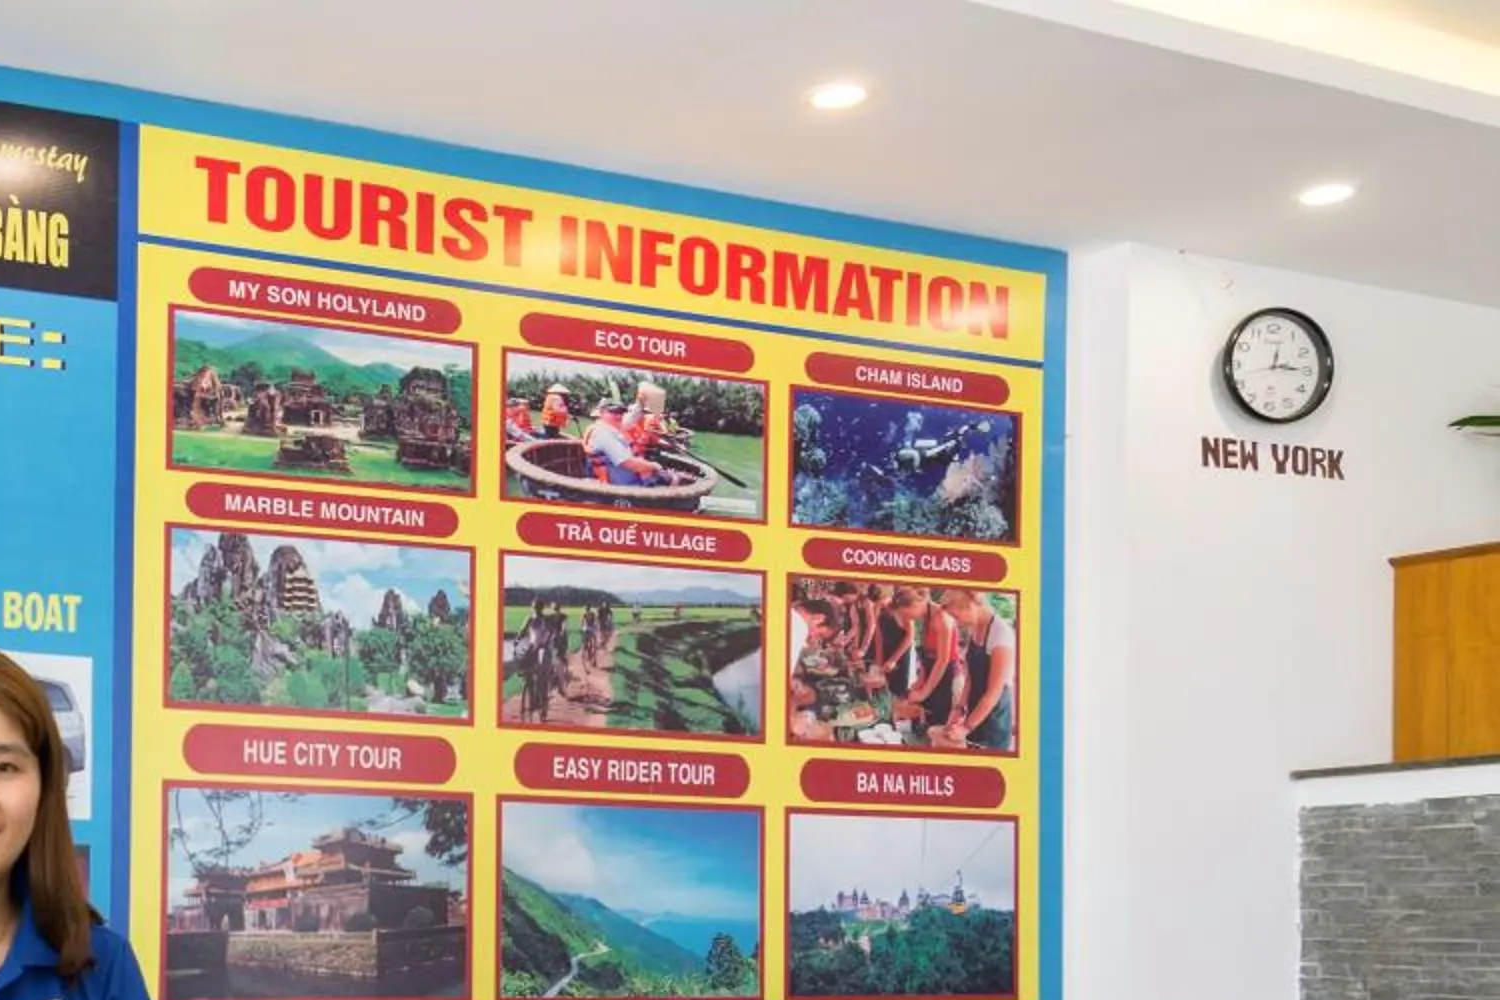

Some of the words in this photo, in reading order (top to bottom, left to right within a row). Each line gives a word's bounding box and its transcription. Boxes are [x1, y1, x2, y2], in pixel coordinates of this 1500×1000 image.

[194, 155, 534, 268] TOURIST
[559, 214, 1011, 341] INFORMATION
[227, 278, 260, 300] MY
[266, 283, 311, 308] SON
[317, 290, 426, 323] HOLYLAND
[595, 329, 633, 353] ECO
[637, 335, 687, 359] TOUR
[855, 365, 903, 388] CHAM
[906, 370, 964, 394] ISLAND
[1201, 436, 1258, 471] NEW
[224, 494, 314, 518] MARBLE
[320, 502, 425, 528] MOUNTAIN
[556, 519, 593, 542] TRÀ
[599, 521, 638, 547] QUẾ
[642, 530, 717, 553] VILLAGE
[842, 547, 916, 570] COOKING
[920, 554, 971, 573] CLASS
[3, 590, 83, 633] BOAT
[242, 739, 287, 765] HUE
[293, 742, 341, 768] CITY
[346, 744, 402, 770] TOUR
[552, 755, 602, 780] EASY
[607, 759, 663, 783] RIDER
[667, 762, 716, 786] TOUR
[856, 772, 880, 794] BA
[882, 773, 905, 794] NA
[908, 774, 954, 796] HILLS
